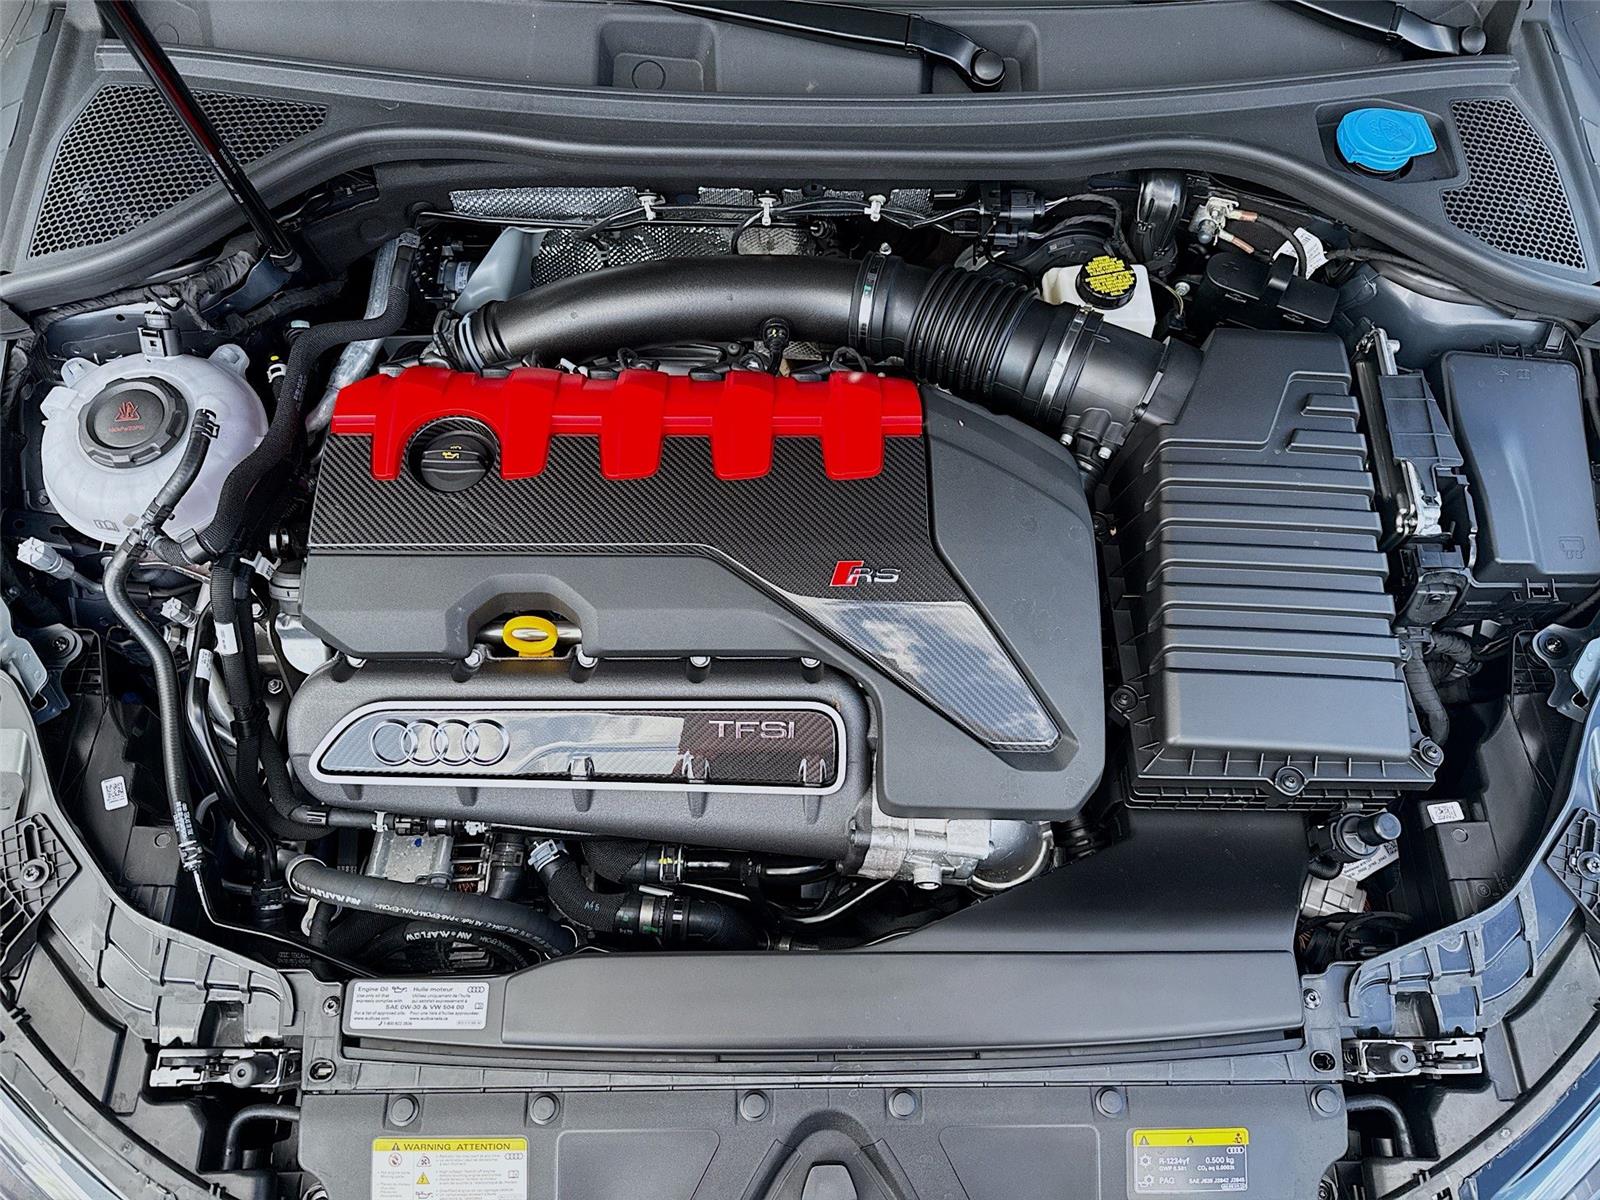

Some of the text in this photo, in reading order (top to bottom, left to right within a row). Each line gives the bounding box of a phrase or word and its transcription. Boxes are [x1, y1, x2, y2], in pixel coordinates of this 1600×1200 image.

[829, 560, 901, 587] RS
[708, 720, 795, 738] TFSI
[404, 1143, 511, 1151] WARNING ATTENTION
[1226, 1156, 1235, 1165] kg
